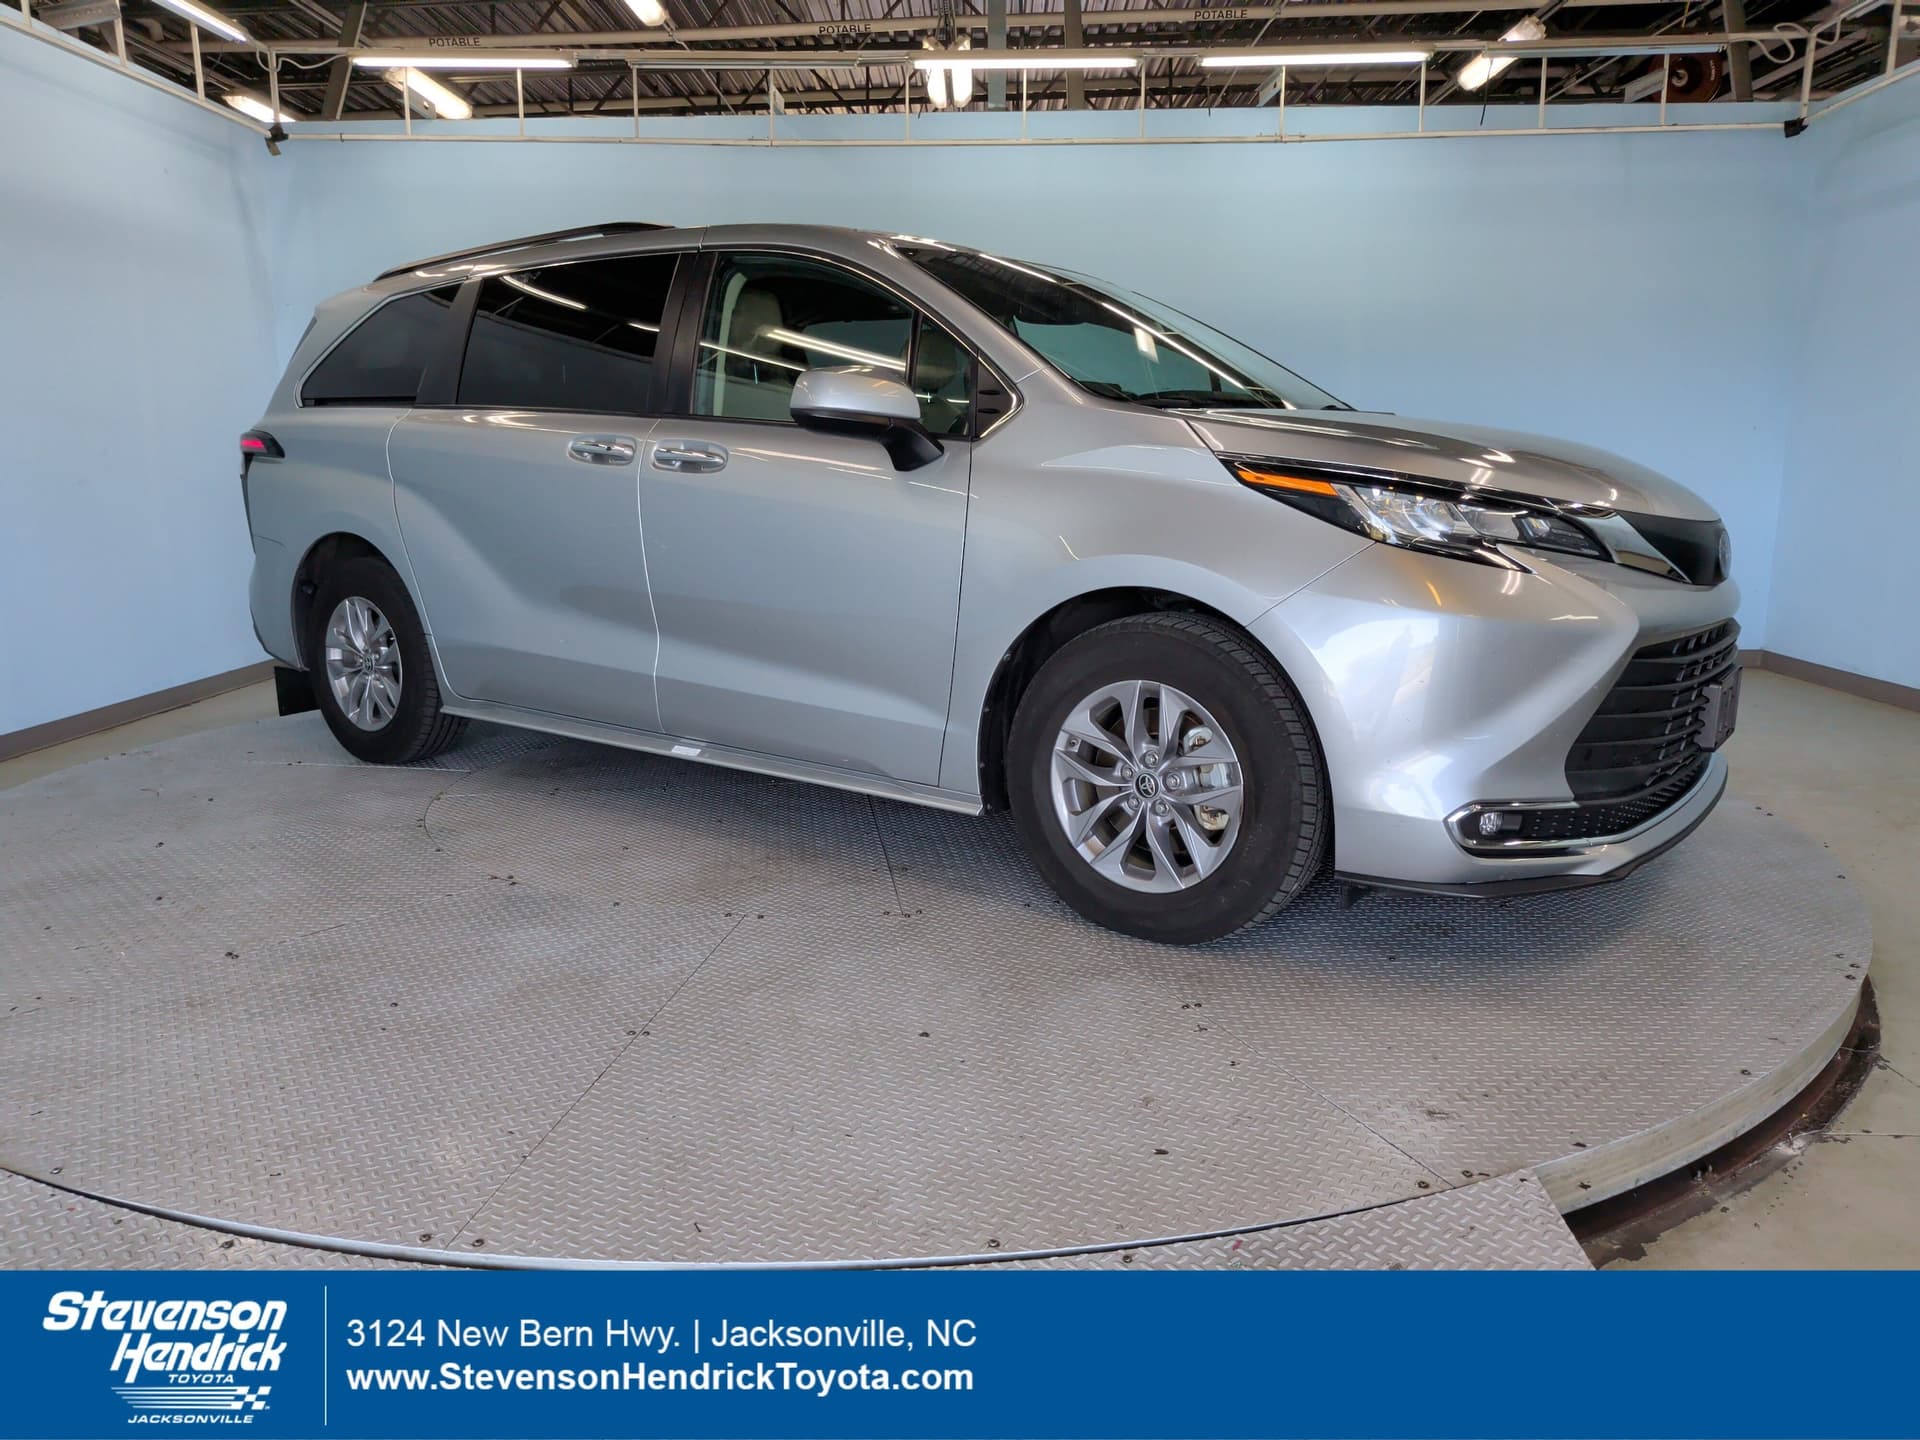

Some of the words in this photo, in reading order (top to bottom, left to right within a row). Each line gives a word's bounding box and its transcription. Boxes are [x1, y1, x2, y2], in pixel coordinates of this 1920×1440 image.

[1193, 8, 1248, 20] POTABLE
[818, 23, 872, 34] POTABLE
[428, 36, 481, 48] POTABLE
